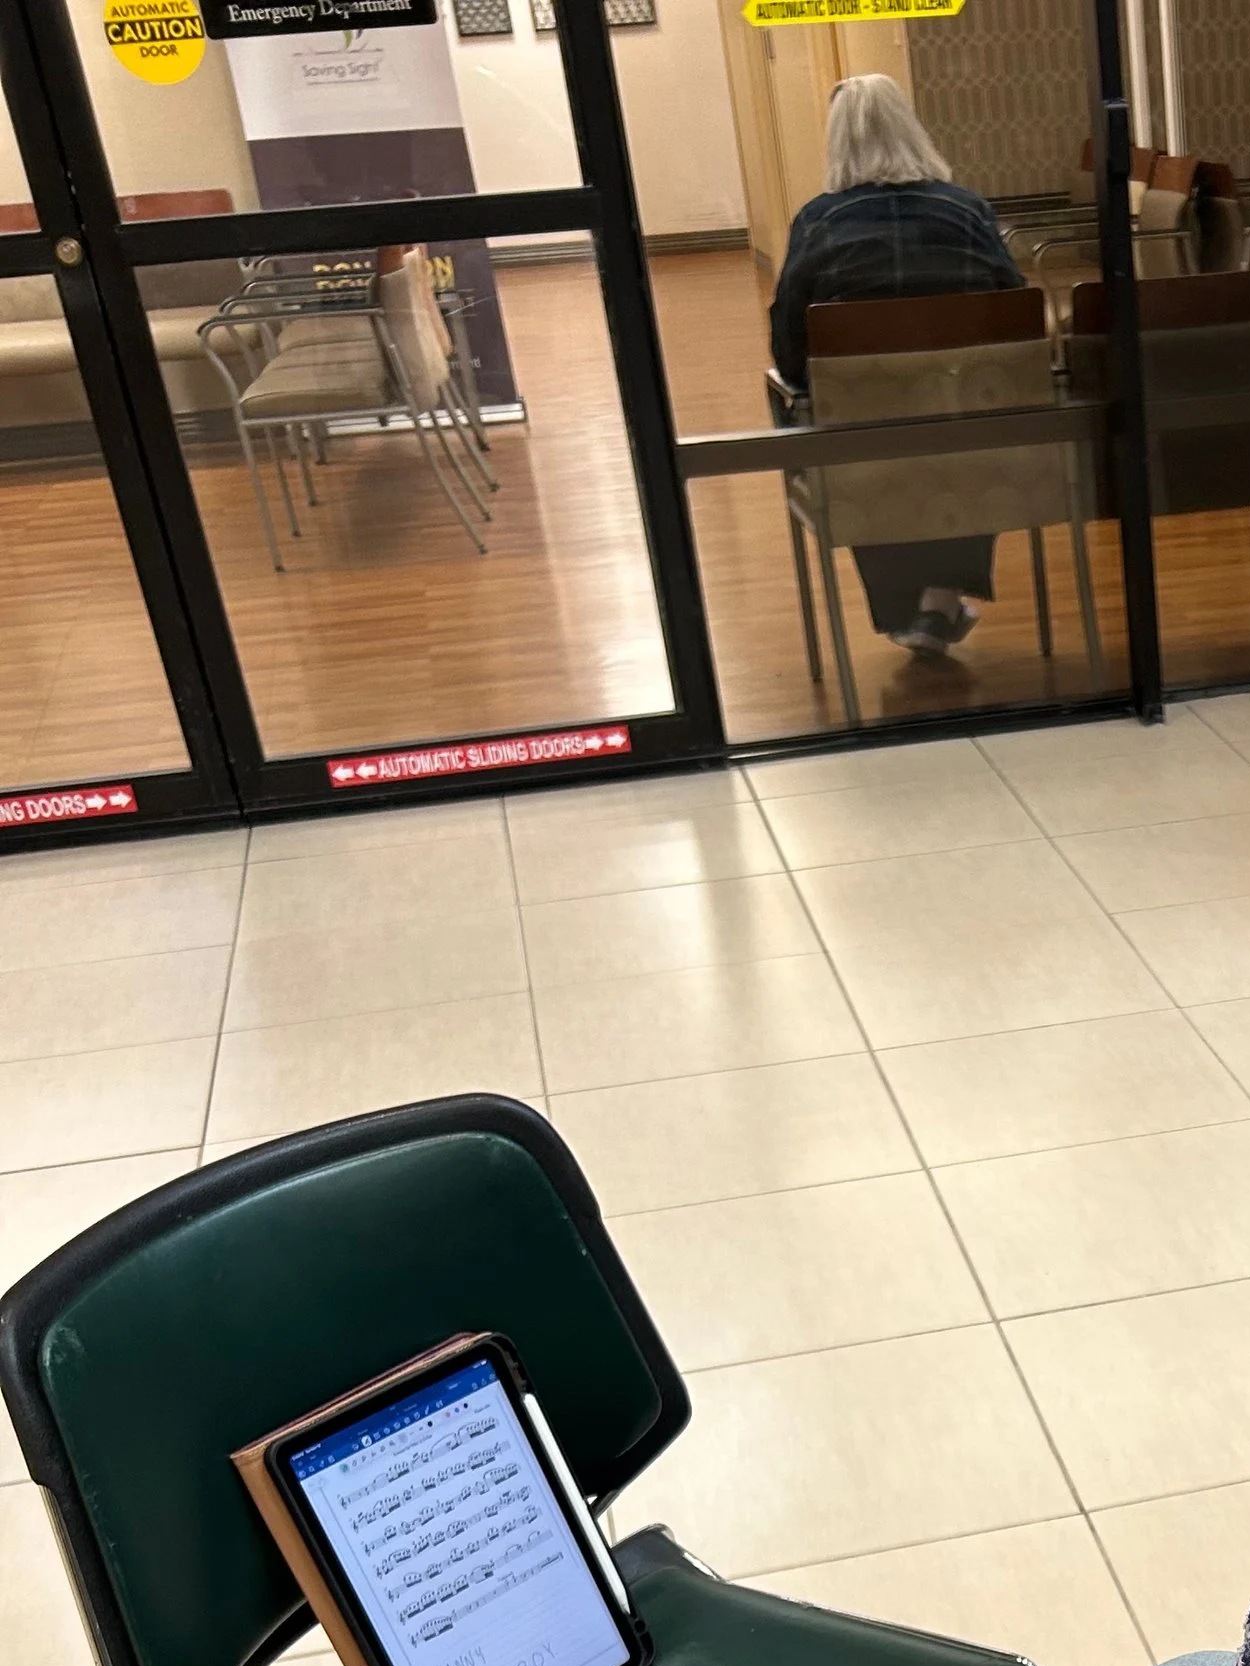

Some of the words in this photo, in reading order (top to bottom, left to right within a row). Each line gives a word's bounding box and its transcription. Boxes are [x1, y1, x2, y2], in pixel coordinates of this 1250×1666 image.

[111, 1, 190, 17] AUTOMATIC
[228, 3, 316, 24] Emergency
[319, 0, 412, 19] Department
[756, 1, 825, 19] AUTOMATIC
[827, 0, 861, 16] DOOR
[872, 0, 911, 13] STAND
[107, 19, 202, 42] CAUTION
[139, 44, 179, 58] DOOR
[378, 748, 466, 780] AUTOMATIC
[465, 740, 529, 768] SLIDING
[529, 735, 585, 760] DOORS
[25, 794, 87, 819] DOORS
